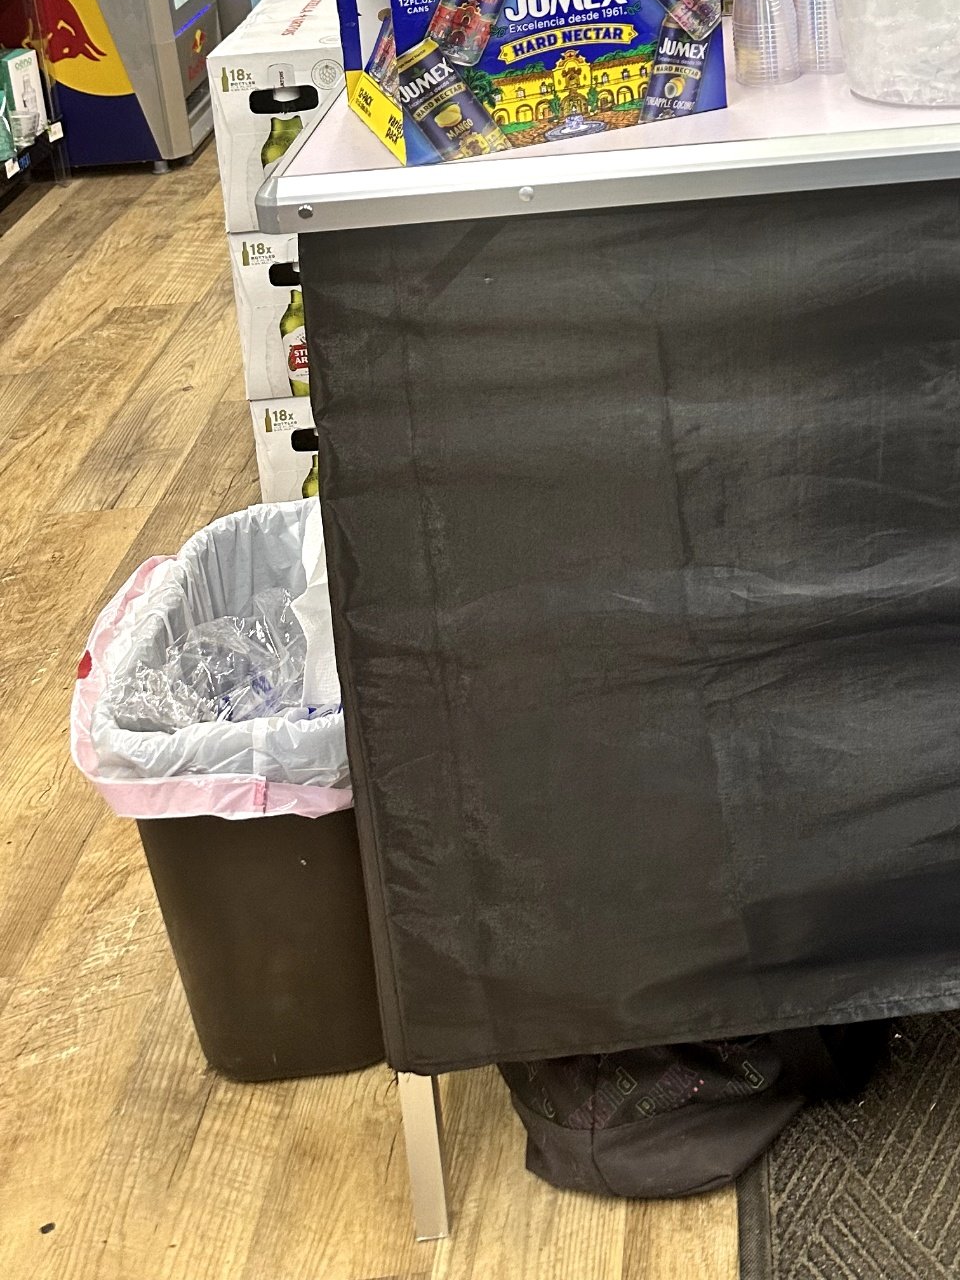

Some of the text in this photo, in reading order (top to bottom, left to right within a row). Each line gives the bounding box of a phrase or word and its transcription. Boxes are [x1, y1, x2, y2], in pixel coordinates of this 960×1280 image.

[407, 6, 429, 14] CANS
[509, 16, 565, 33] Excelencia
[568, 12, 599, 26] desde
[513, 27, 622, 56] HARD NECTAR
[230, 69, 251, 81] 18x
[250, 243, 272, 255] 18x
[273, 410, 294, 421] 18x
